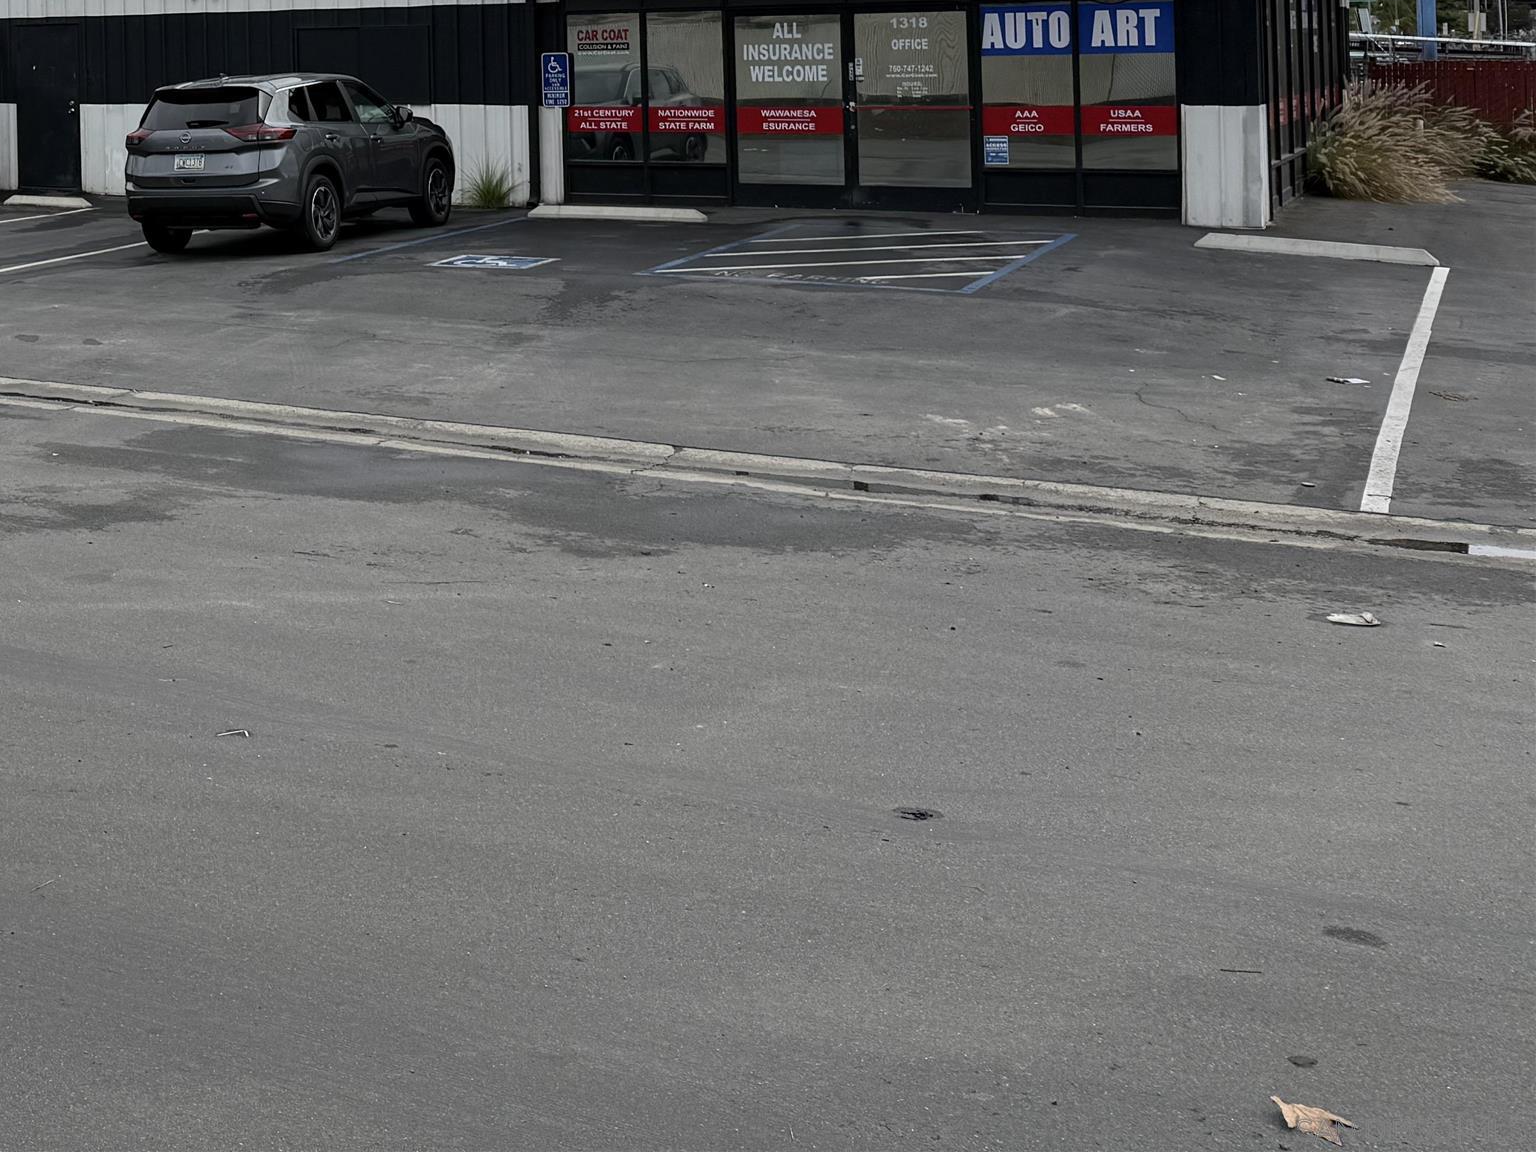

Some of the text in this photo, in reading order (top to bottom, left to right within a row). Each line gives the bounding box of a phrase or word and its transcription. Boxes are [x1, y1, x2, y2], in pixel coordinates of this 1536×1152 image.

[890, 17, 928, 29] 1318
[772, 22, 801, 39] ALL
[981, 8, 1161, 49] AUTO ART
[577, 29, 629, 41] CAR COAT
[891, 38, 928, 50] OFFICE
[743, 43, 834, 61] INSURANCE
[750, 64, 827, 82] WELCOME
[889, 65, 934, 73] 760-747-1242
[593, 109, 634, 117] CENTURY
[761, 110, 816, 118] WAWANESA
[1015, 110, 1039, 118] AAA
[1110, 110, 1142, 118] USAA
[658, 122, 715, 130] STATE FARM
[762, 122, 816, 131] ESURANCE
[1010, 124, 1044, 132] GEICO
[1100, 124, 1153, 132] FARMERS
